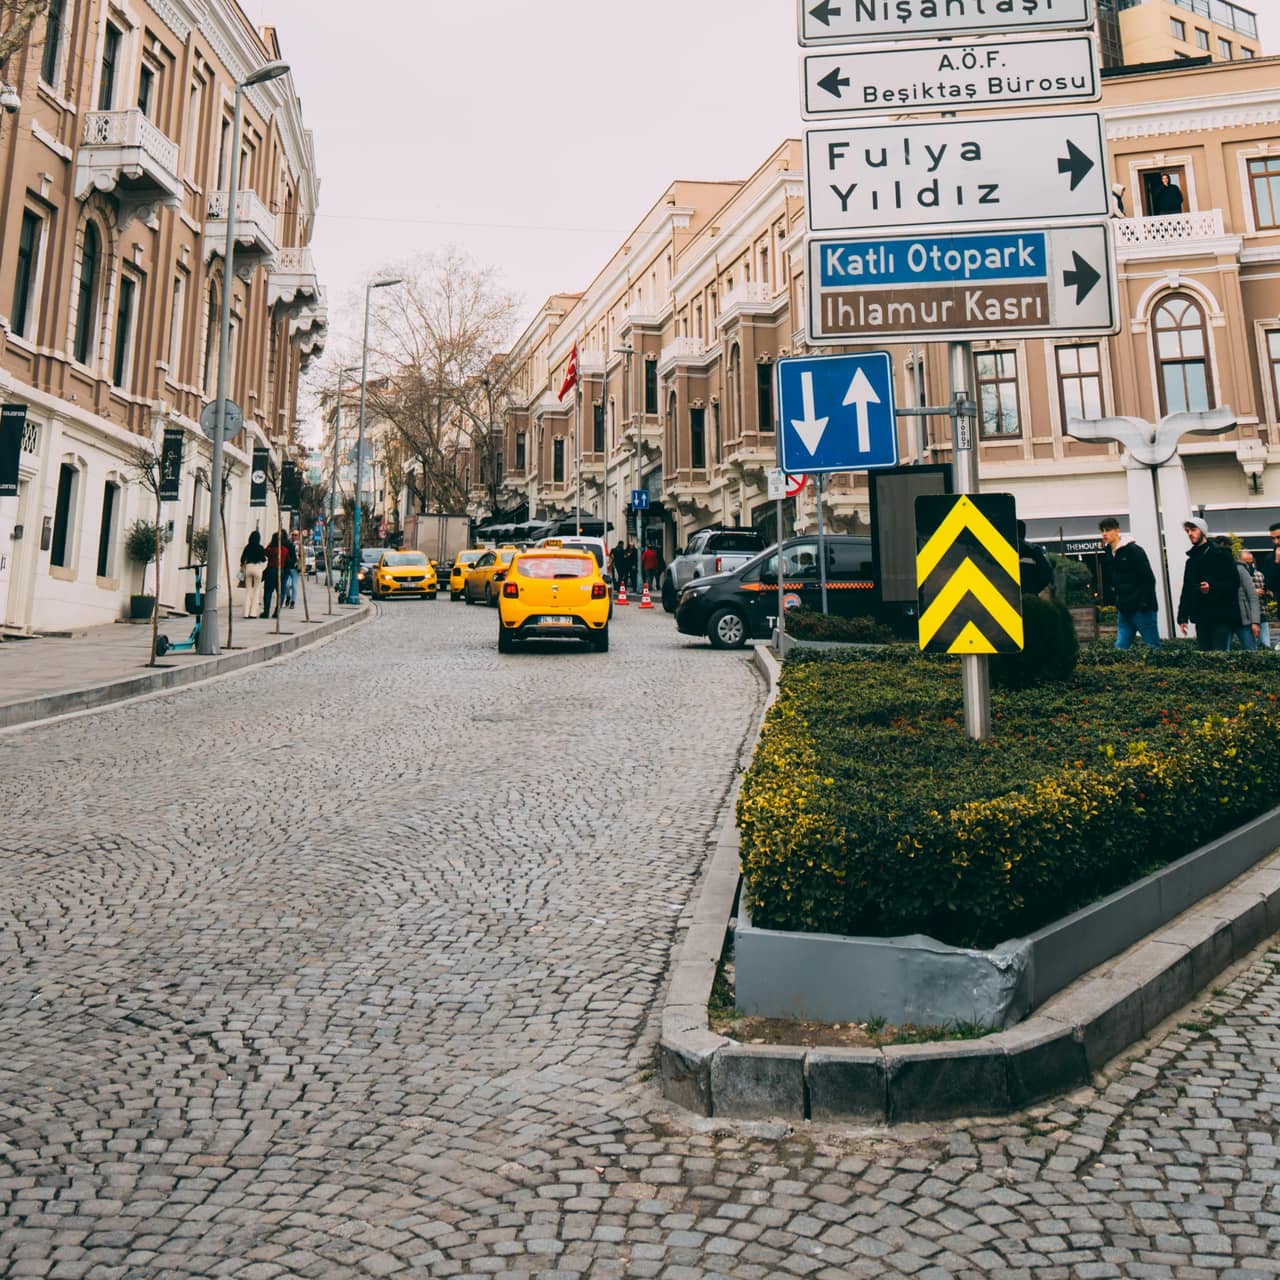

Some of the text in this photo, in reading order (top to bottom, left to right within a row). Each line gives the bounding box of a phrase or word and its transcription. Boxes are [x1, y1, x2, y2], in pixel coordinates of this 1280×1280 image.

[938, 47, 1006, 72] A.Ö.F.
[863, 75, 1086, 104] Beşiktaş Bürosu
[828, 137, 982, 173] Fulya
[829, 178, 1001, 212] Yıldız
[827, 238, 1036, 278] Katlı Otopark
[827, 291, 1042, 327] Ihlamur Kasrı
